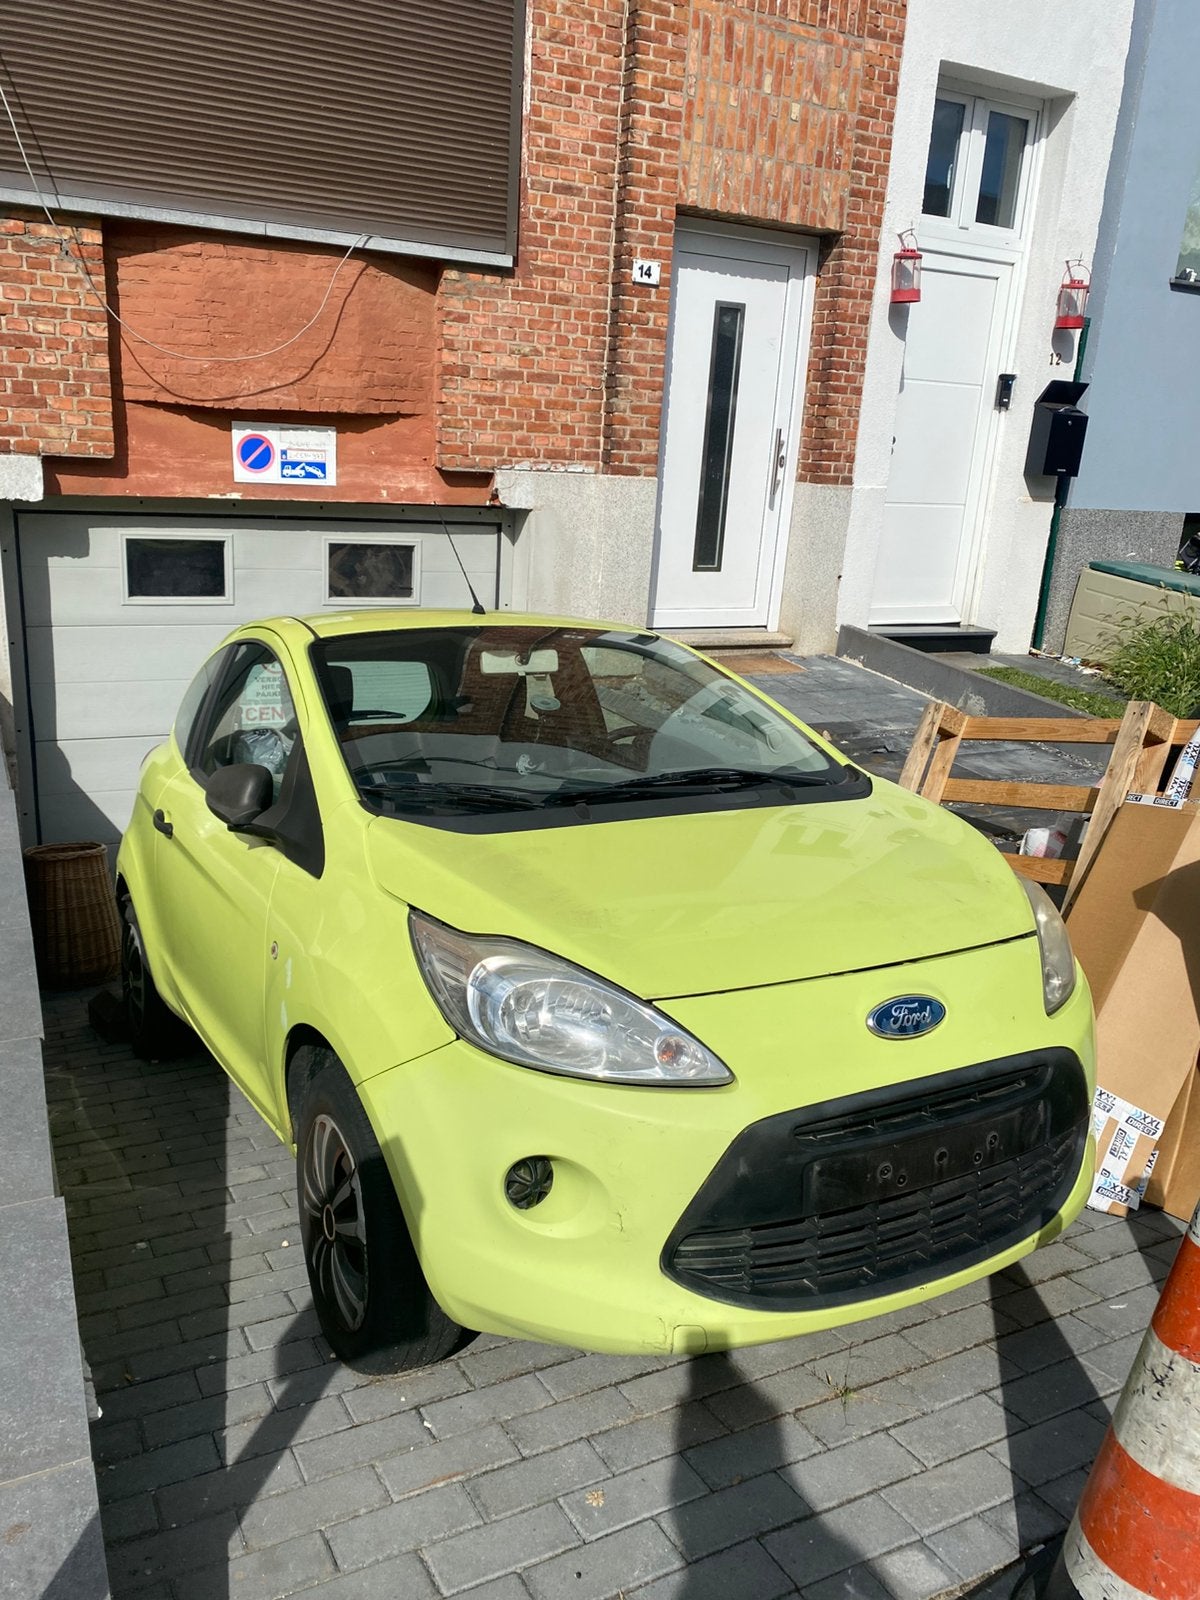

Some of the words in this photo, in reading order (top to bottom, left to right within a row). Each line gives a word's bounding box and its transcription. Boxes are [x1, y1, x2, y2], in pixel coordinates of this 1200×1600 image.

[638, 264, 652, 279] 14
[1050, 352, 1062, 366] 12
[890, 1002, 932, 1029] Ford
[1125, 1116, 1158, 1136] DIRECT
[1140, 1113, 1161, 1130] XXL
[1111, 1183, 1131, 1198] XXL
